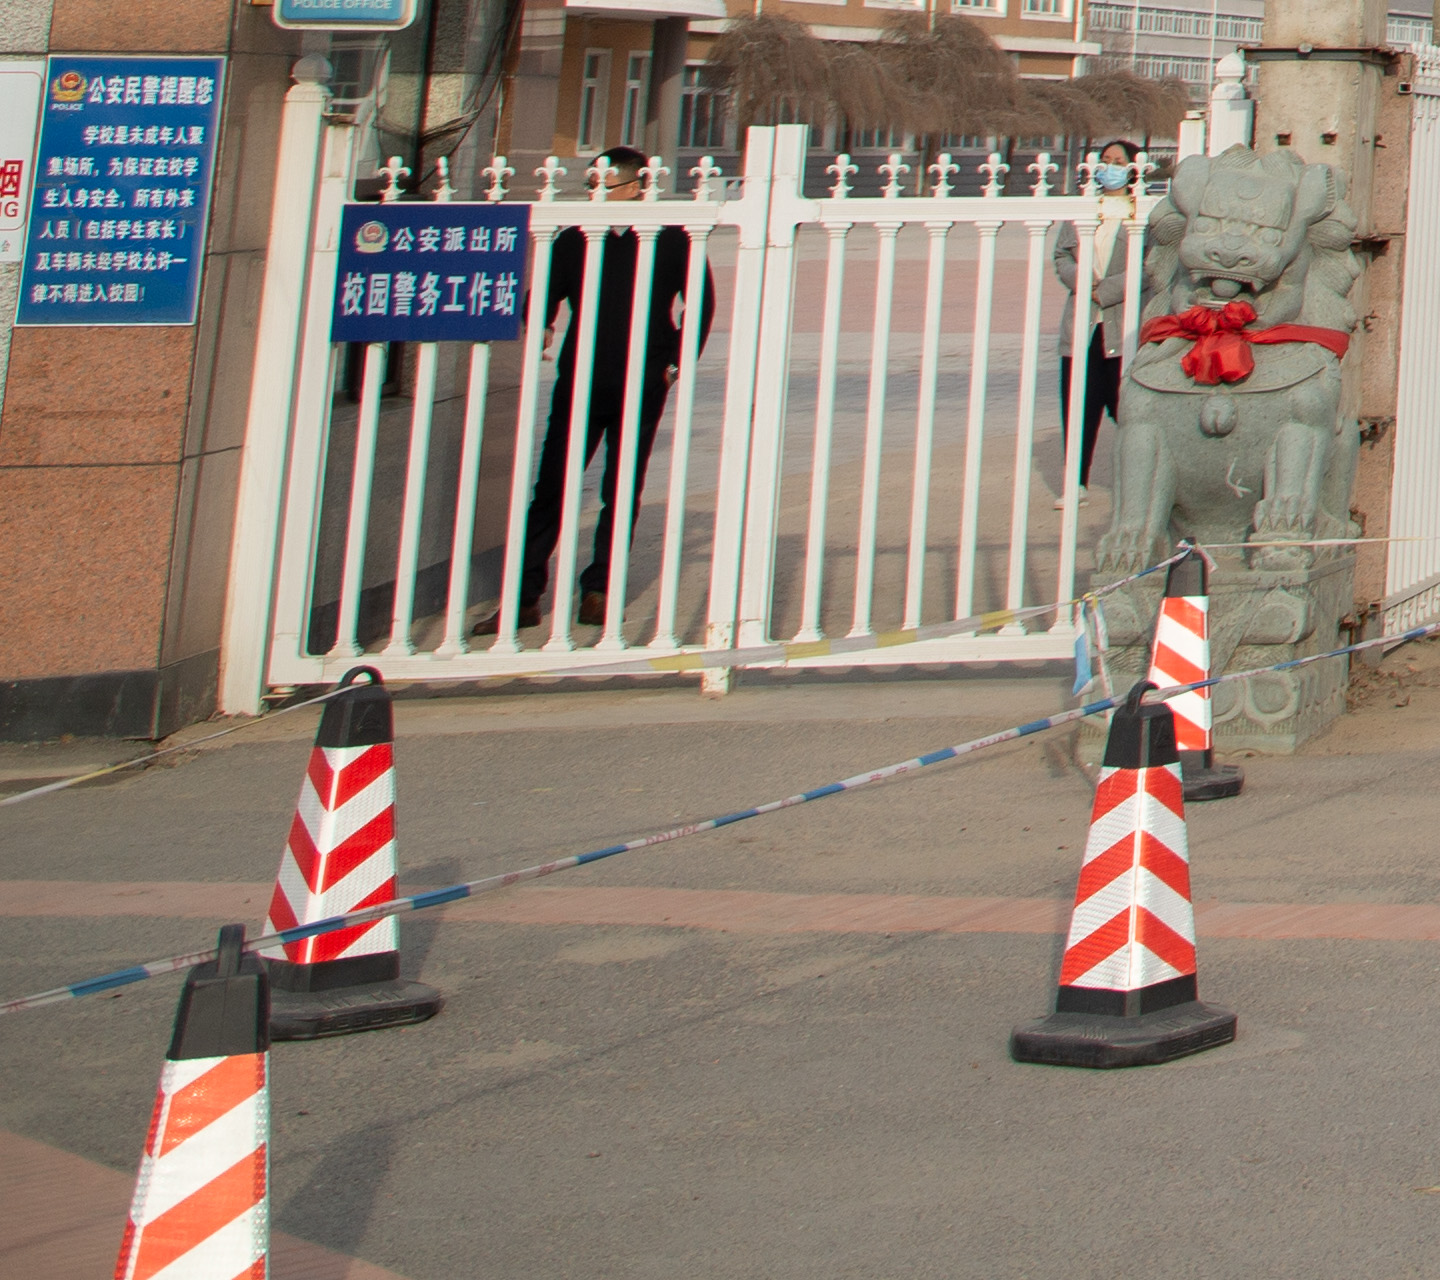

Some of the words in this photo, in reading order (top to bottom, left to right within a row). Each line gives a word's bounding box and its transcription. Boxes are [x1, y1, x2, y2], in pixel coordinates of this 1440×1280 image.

[89, 75, 214, 105] 公安民警提醒您
[51, 103, 84, 111] POLICE
[84, 126, 205, 145] 学校是未成年人聚
[392, 226, 517, 253] 公安派出所
[35, 252, 188, 271] 及车辆未经学校允许一
[341, 271, 518, 318] 校园警务工作站
